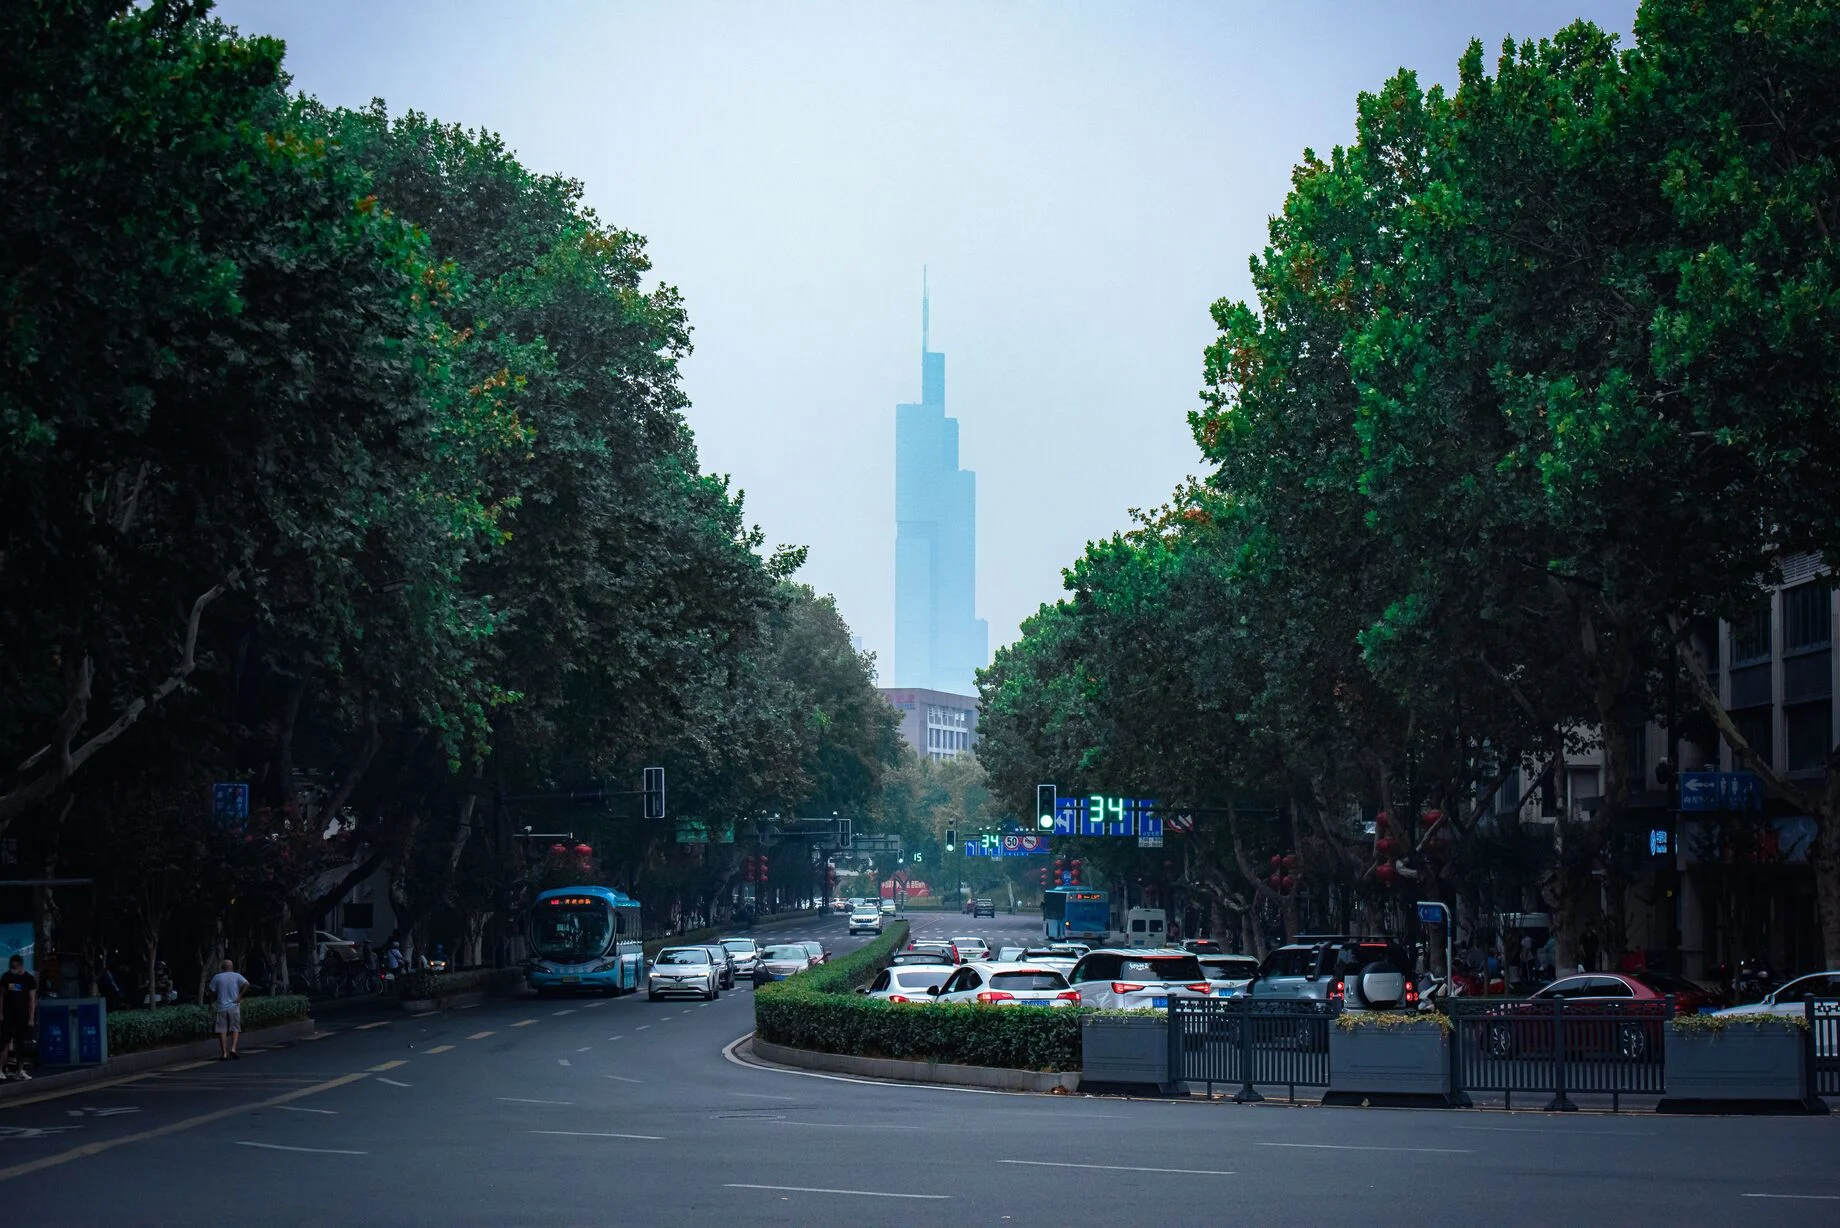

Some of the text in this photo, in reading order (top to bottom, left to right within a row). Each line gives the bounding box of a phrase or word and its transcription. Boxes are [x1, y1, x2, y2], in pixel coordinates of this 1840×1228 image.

[1090, 796, 1123, 821] 34
[981, 834, 999, 848] 34
[1007, 837, 1017, 847] 50
[914, 853, 922, 862] 15
